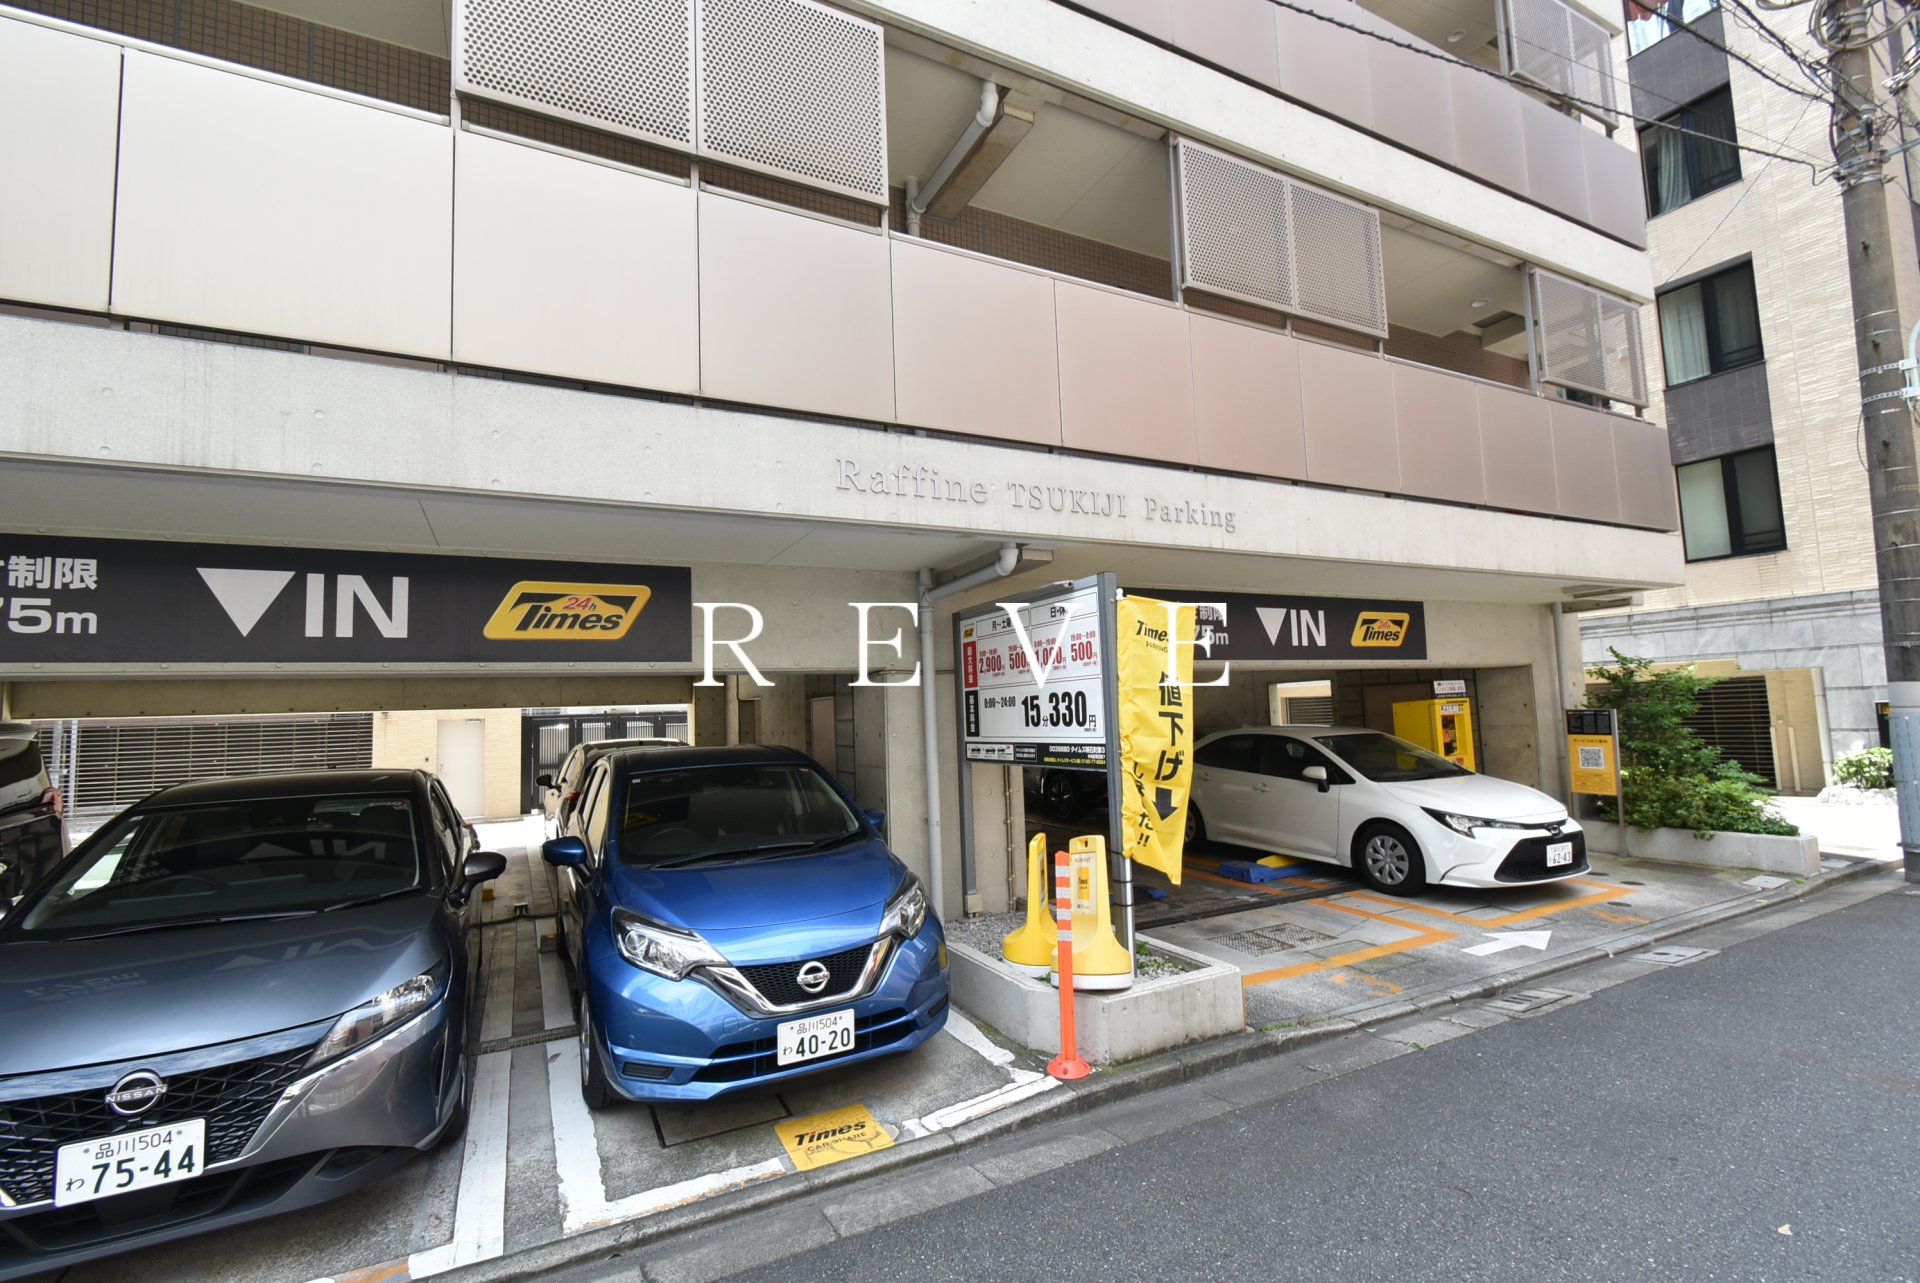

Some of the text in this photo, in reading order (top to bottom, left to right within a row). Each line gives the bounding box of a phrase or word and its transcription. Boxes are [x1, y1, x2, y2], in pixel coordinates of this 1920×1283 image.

[835, 457, 1237, 534] Raffine TSUKIJI Parking
[0, 555, 98, 590] 制限
[0, 597, 97, 634] 5m
[305, 573, 409, 638] IN
[514, 604, 625, 632] Times
[564, 596, 597, 611] 24h
[1290, 609, 1326, 647] IN
[1362, 625, 1400, 641] Times
[797, 1016, 839, 1035] 品川504
[795, 1027, 851, 1057] 40-20
[105, 1086, 167, 1103] NISSAN
[95, 1130, 173, 1160] 品川504
[795, 1121, 866, 1146] Times
[65, 1144, 195, 1194] わ 75-44
